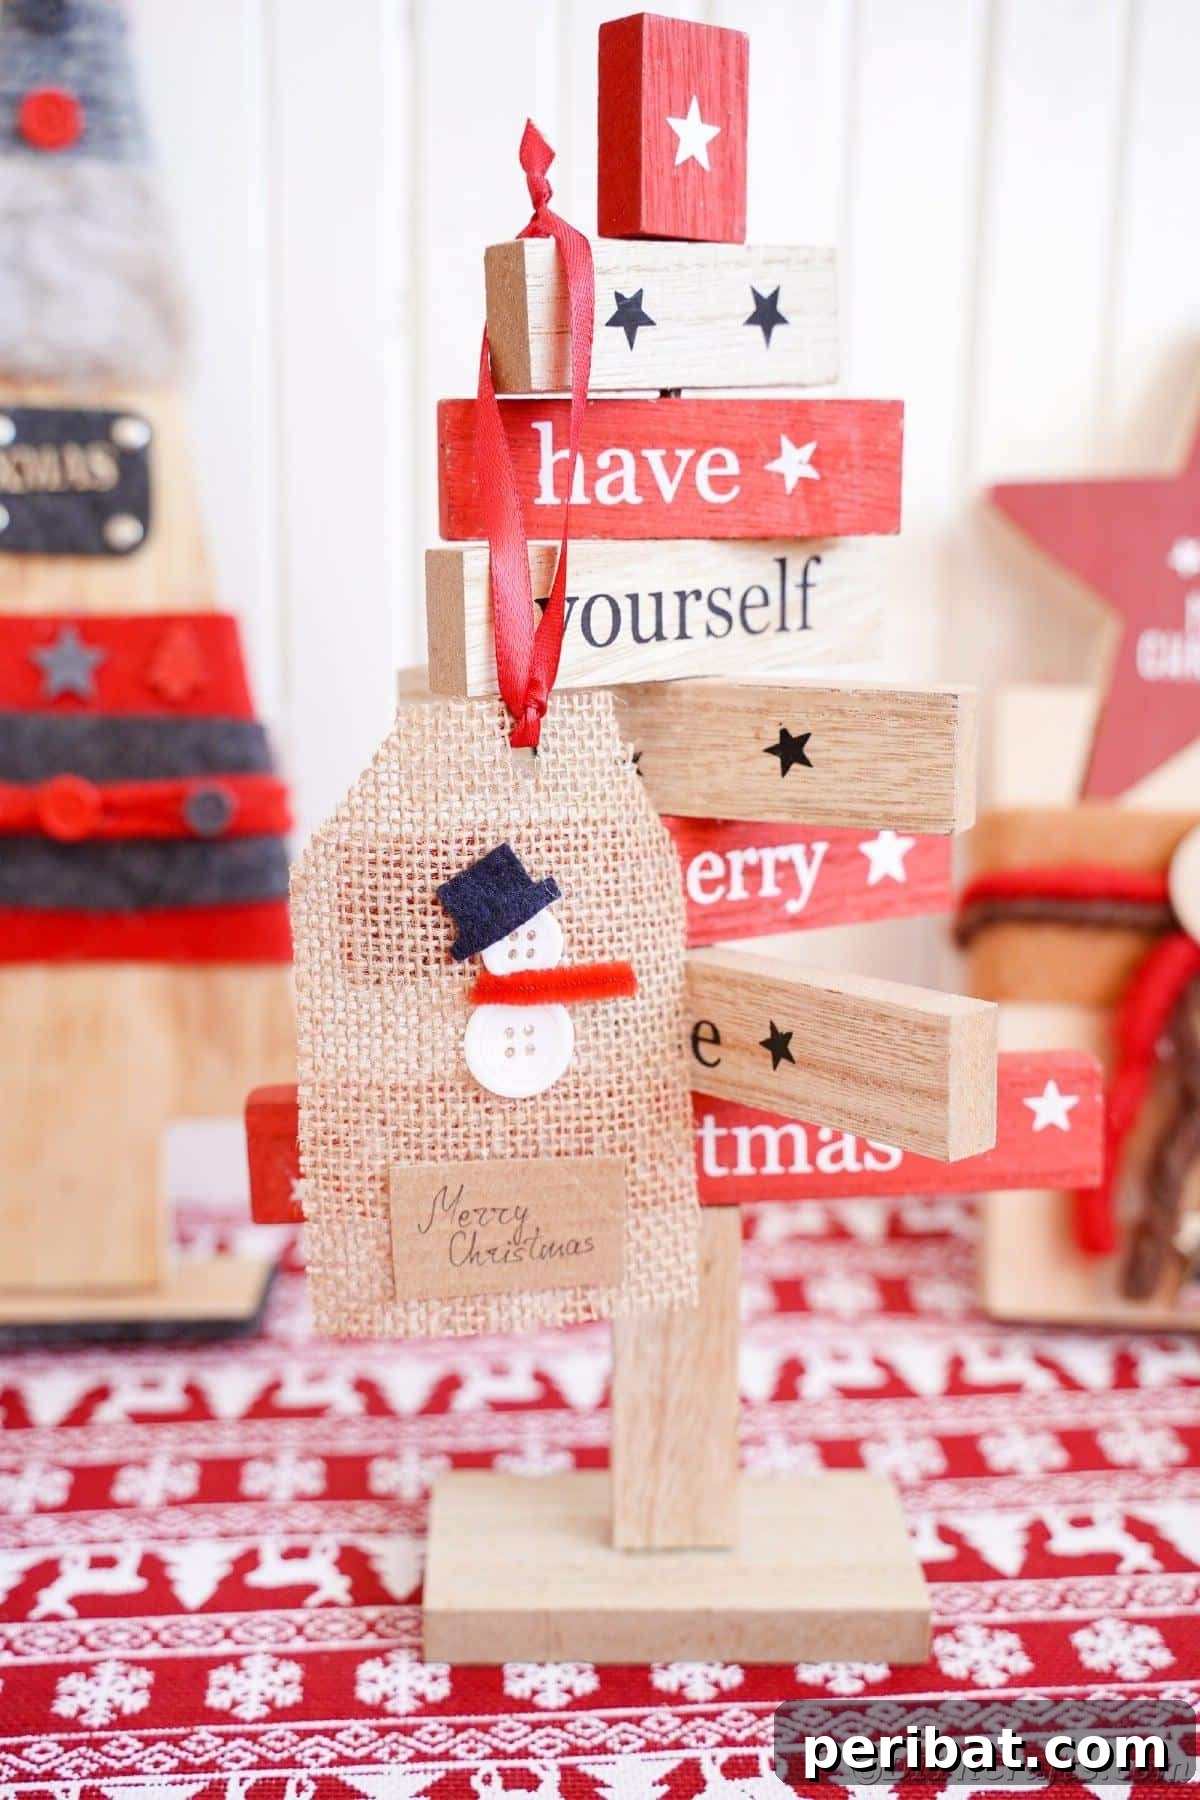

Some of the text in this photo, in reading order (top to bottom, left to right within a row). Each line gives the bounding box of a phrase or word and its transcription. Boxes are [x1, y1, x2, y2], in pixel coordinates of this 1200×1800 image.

[531, 421, 740, 505] have
[418, 1183, 528, 1246] Merry
[449, 1226, 595, 1268] Christmas
